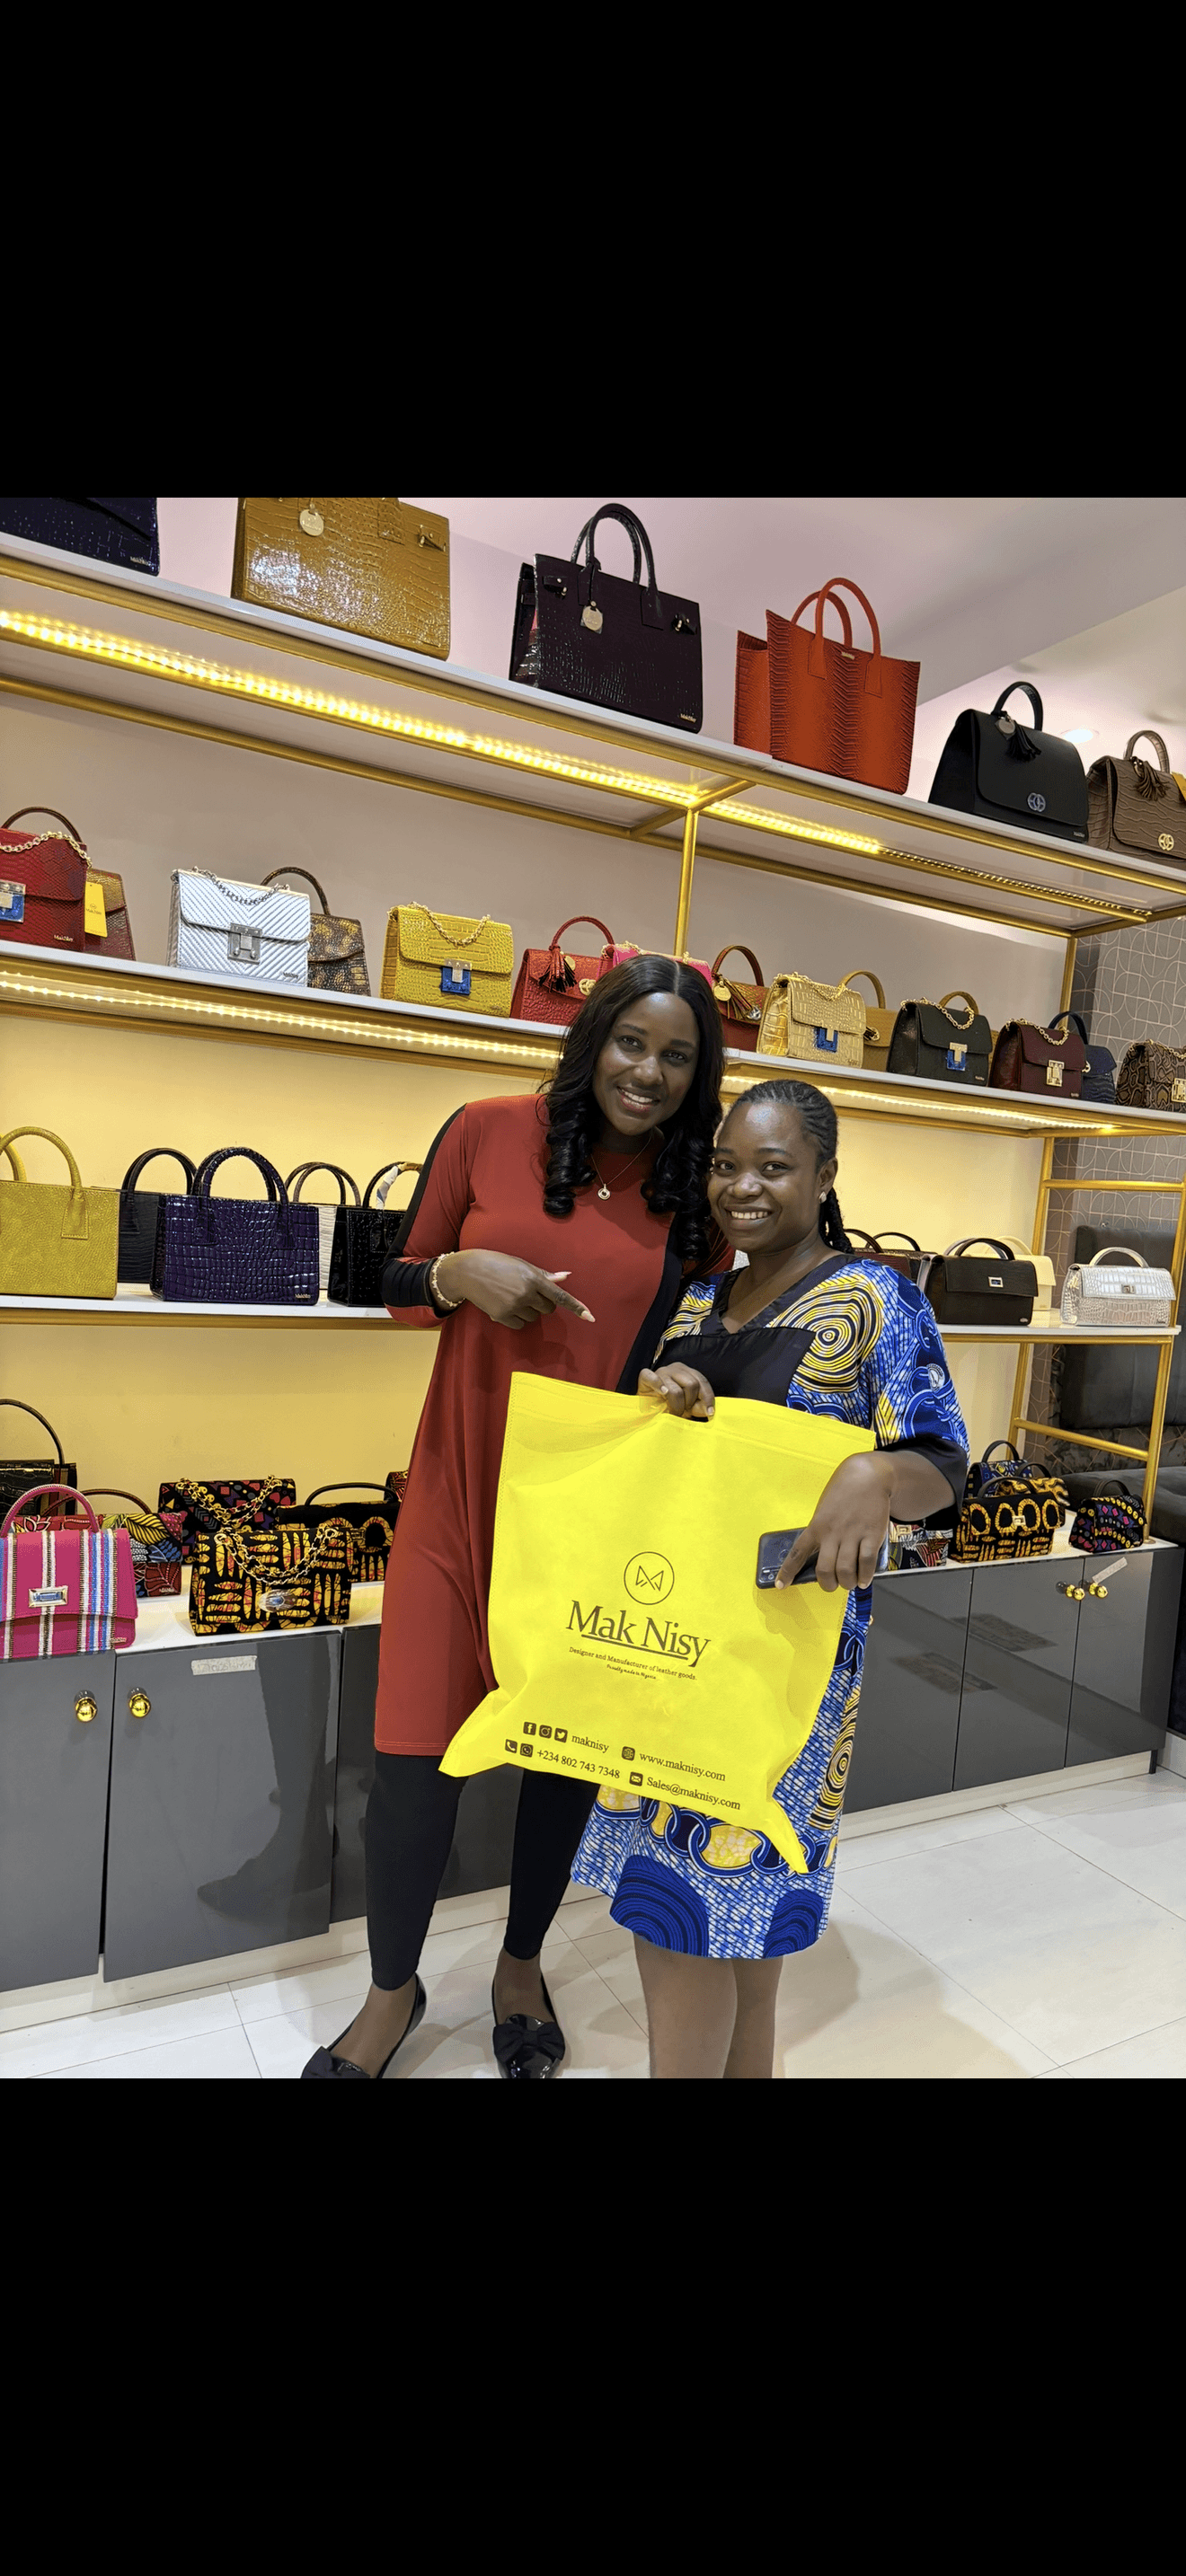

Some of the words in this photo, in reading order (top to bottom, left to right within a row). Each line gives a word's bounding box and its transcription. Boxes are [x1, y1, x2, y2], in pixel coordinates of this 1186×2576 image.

[566, 1600, 637, 1645] Mak
[641, 1617, 712, 1668] Nisy
[569, 1646, 595, 1657] Designer
[606, 1655, 649, 1670] Manufacturer
[656, 1666, 677, 1677] leather
[606, 1663, 623, 1673] Proudly
[571, 1734, 609, 1753] maknisy
[536, 1750, 559, 1763] +234
[561, 1755, 578, 1768] 802
[579, 1760, 596, 1773] 743
[598, 1765, 621, 1779] 7348
[639, 1753, 726, 1781] www.maknisy.com
[646, 1777, 741, 1810] Sales@maknisy.com
